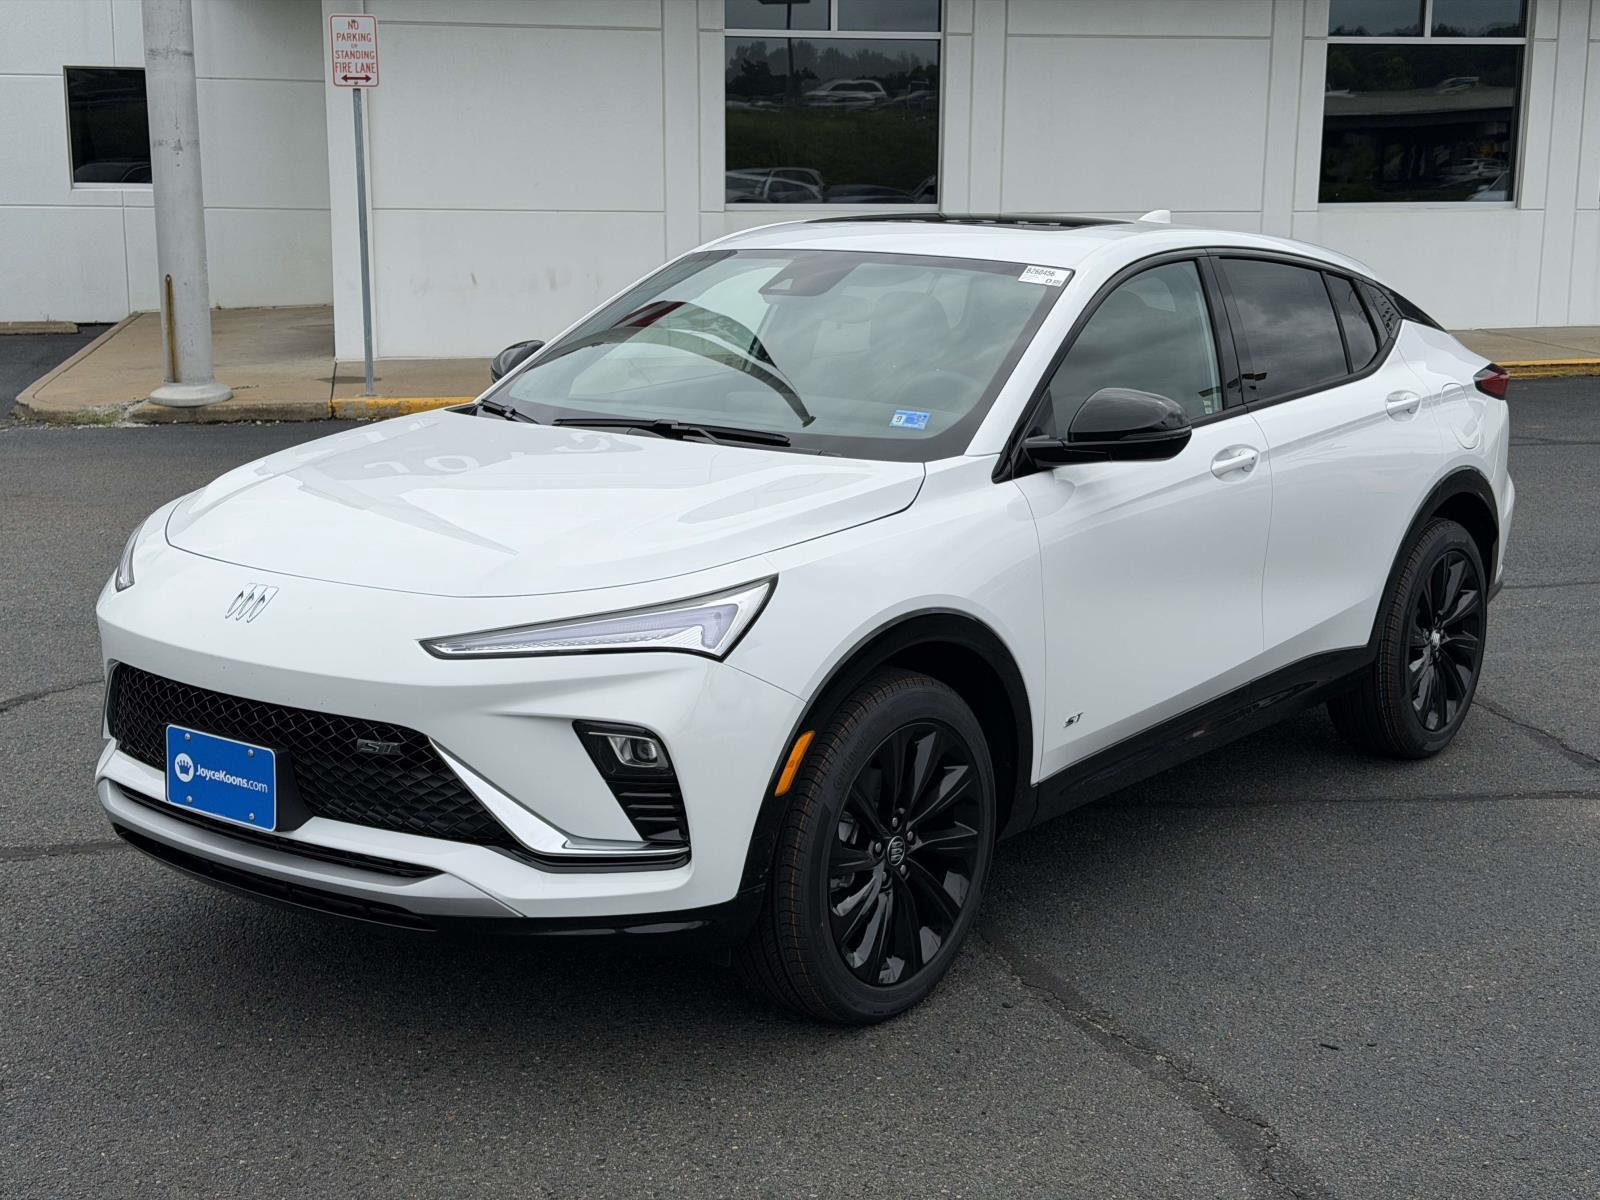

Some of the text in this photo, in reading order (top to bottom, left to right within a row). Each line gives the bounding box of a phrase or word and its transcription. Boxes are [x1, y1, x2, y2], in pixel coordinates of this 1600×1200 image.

[347, 20, 359, 30] NO
[336, 33, 371, 42] PARKING
[335, 50, 375, 60] STANDING
[335, 62, 376, 73] FIRE LANE
[1063, 711, 1084, 728] ST
[358, 739, 399, 754] ST
[195, 764, 268, 793] JoyceKoons.com
